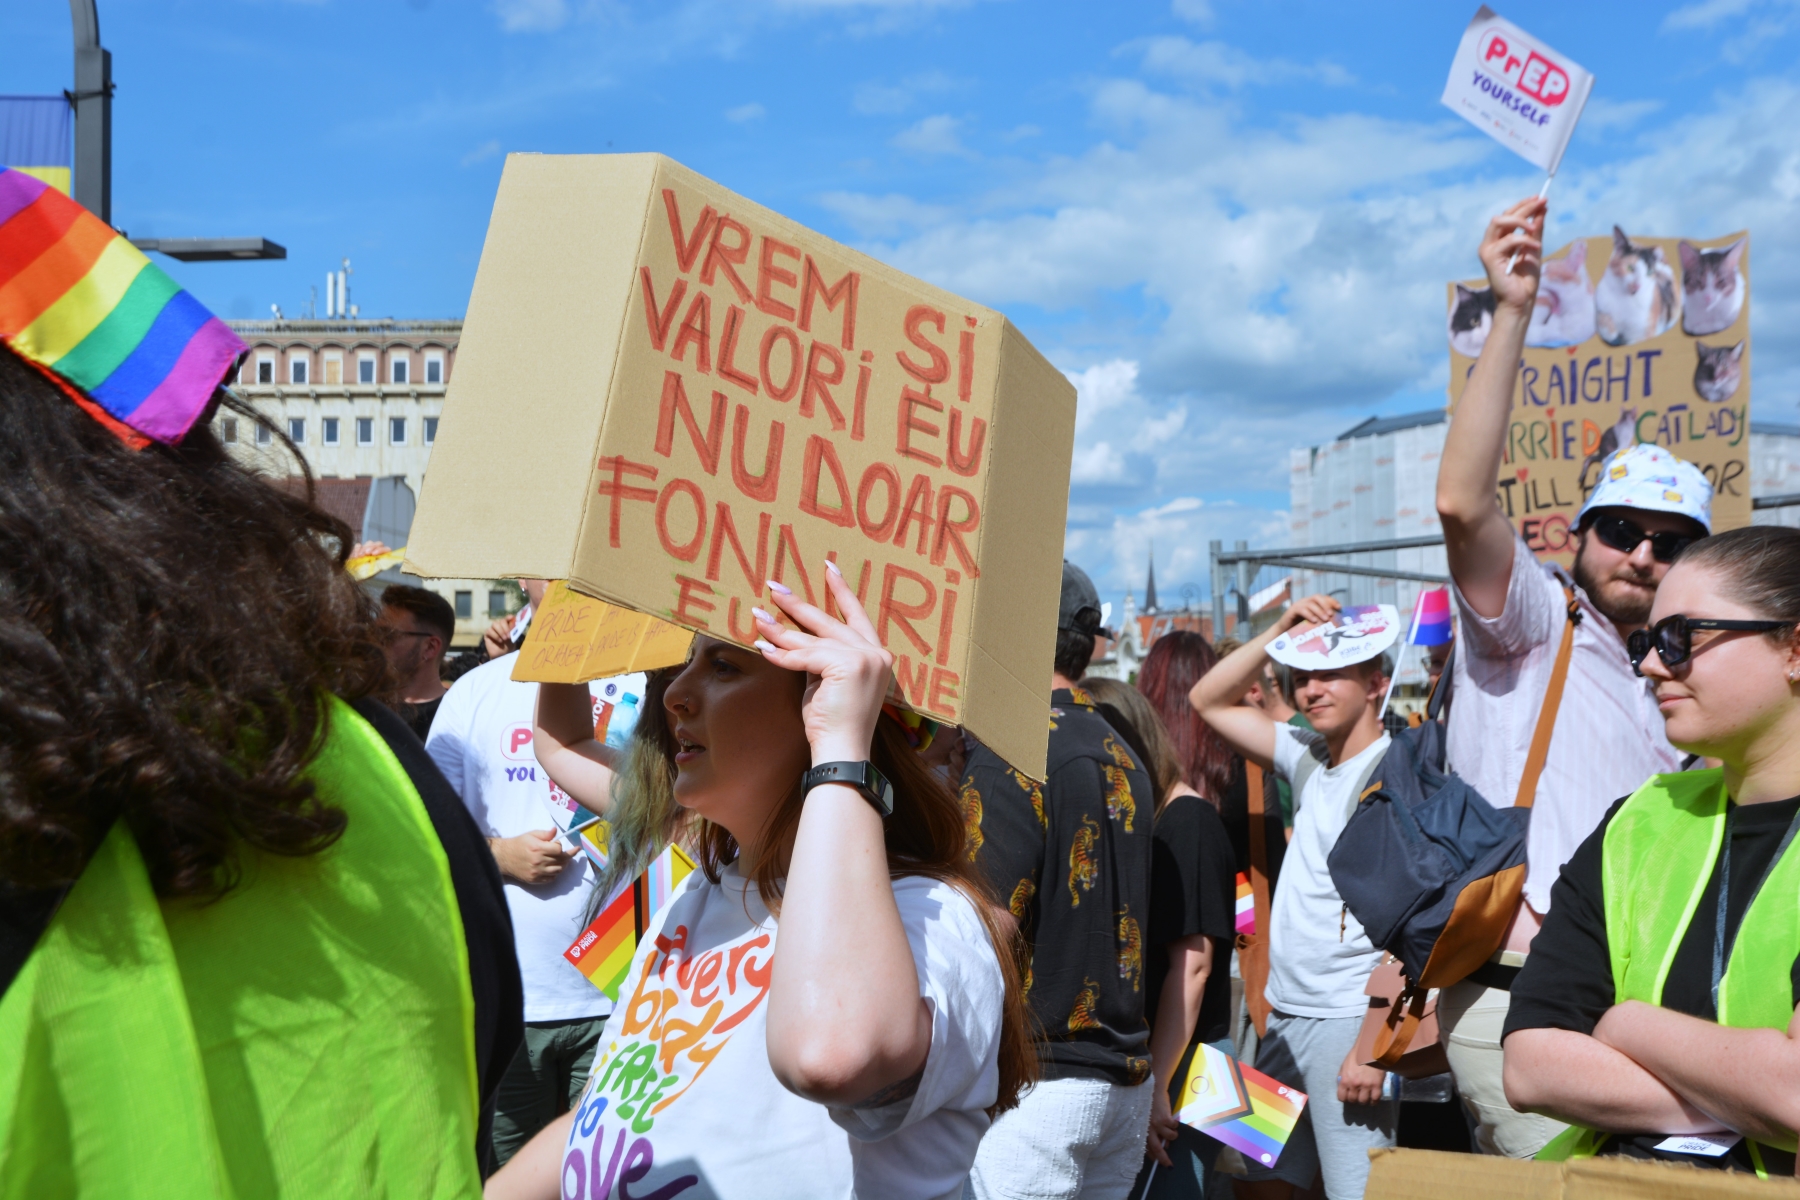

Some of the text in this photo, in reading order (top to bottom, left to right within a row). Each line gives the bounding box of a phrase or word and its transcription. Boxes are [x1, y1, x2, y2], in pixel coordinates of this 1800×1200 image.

[1485, 35, 1569, 101] PrEP
[662, 189, 860, 351] VREM
[1467, 350, 1662, 410] RAIGHT
[895, 384, 987, 477] EU
[654, 370, 981, 579] NU DOAR
[535, 605, 592, 643] PRIDE
[580, 934, 598, 950] PRIDE
[596, 1041, 679, 1134] FREE
[1678, 1144, 1708, 1152] PRIDE
